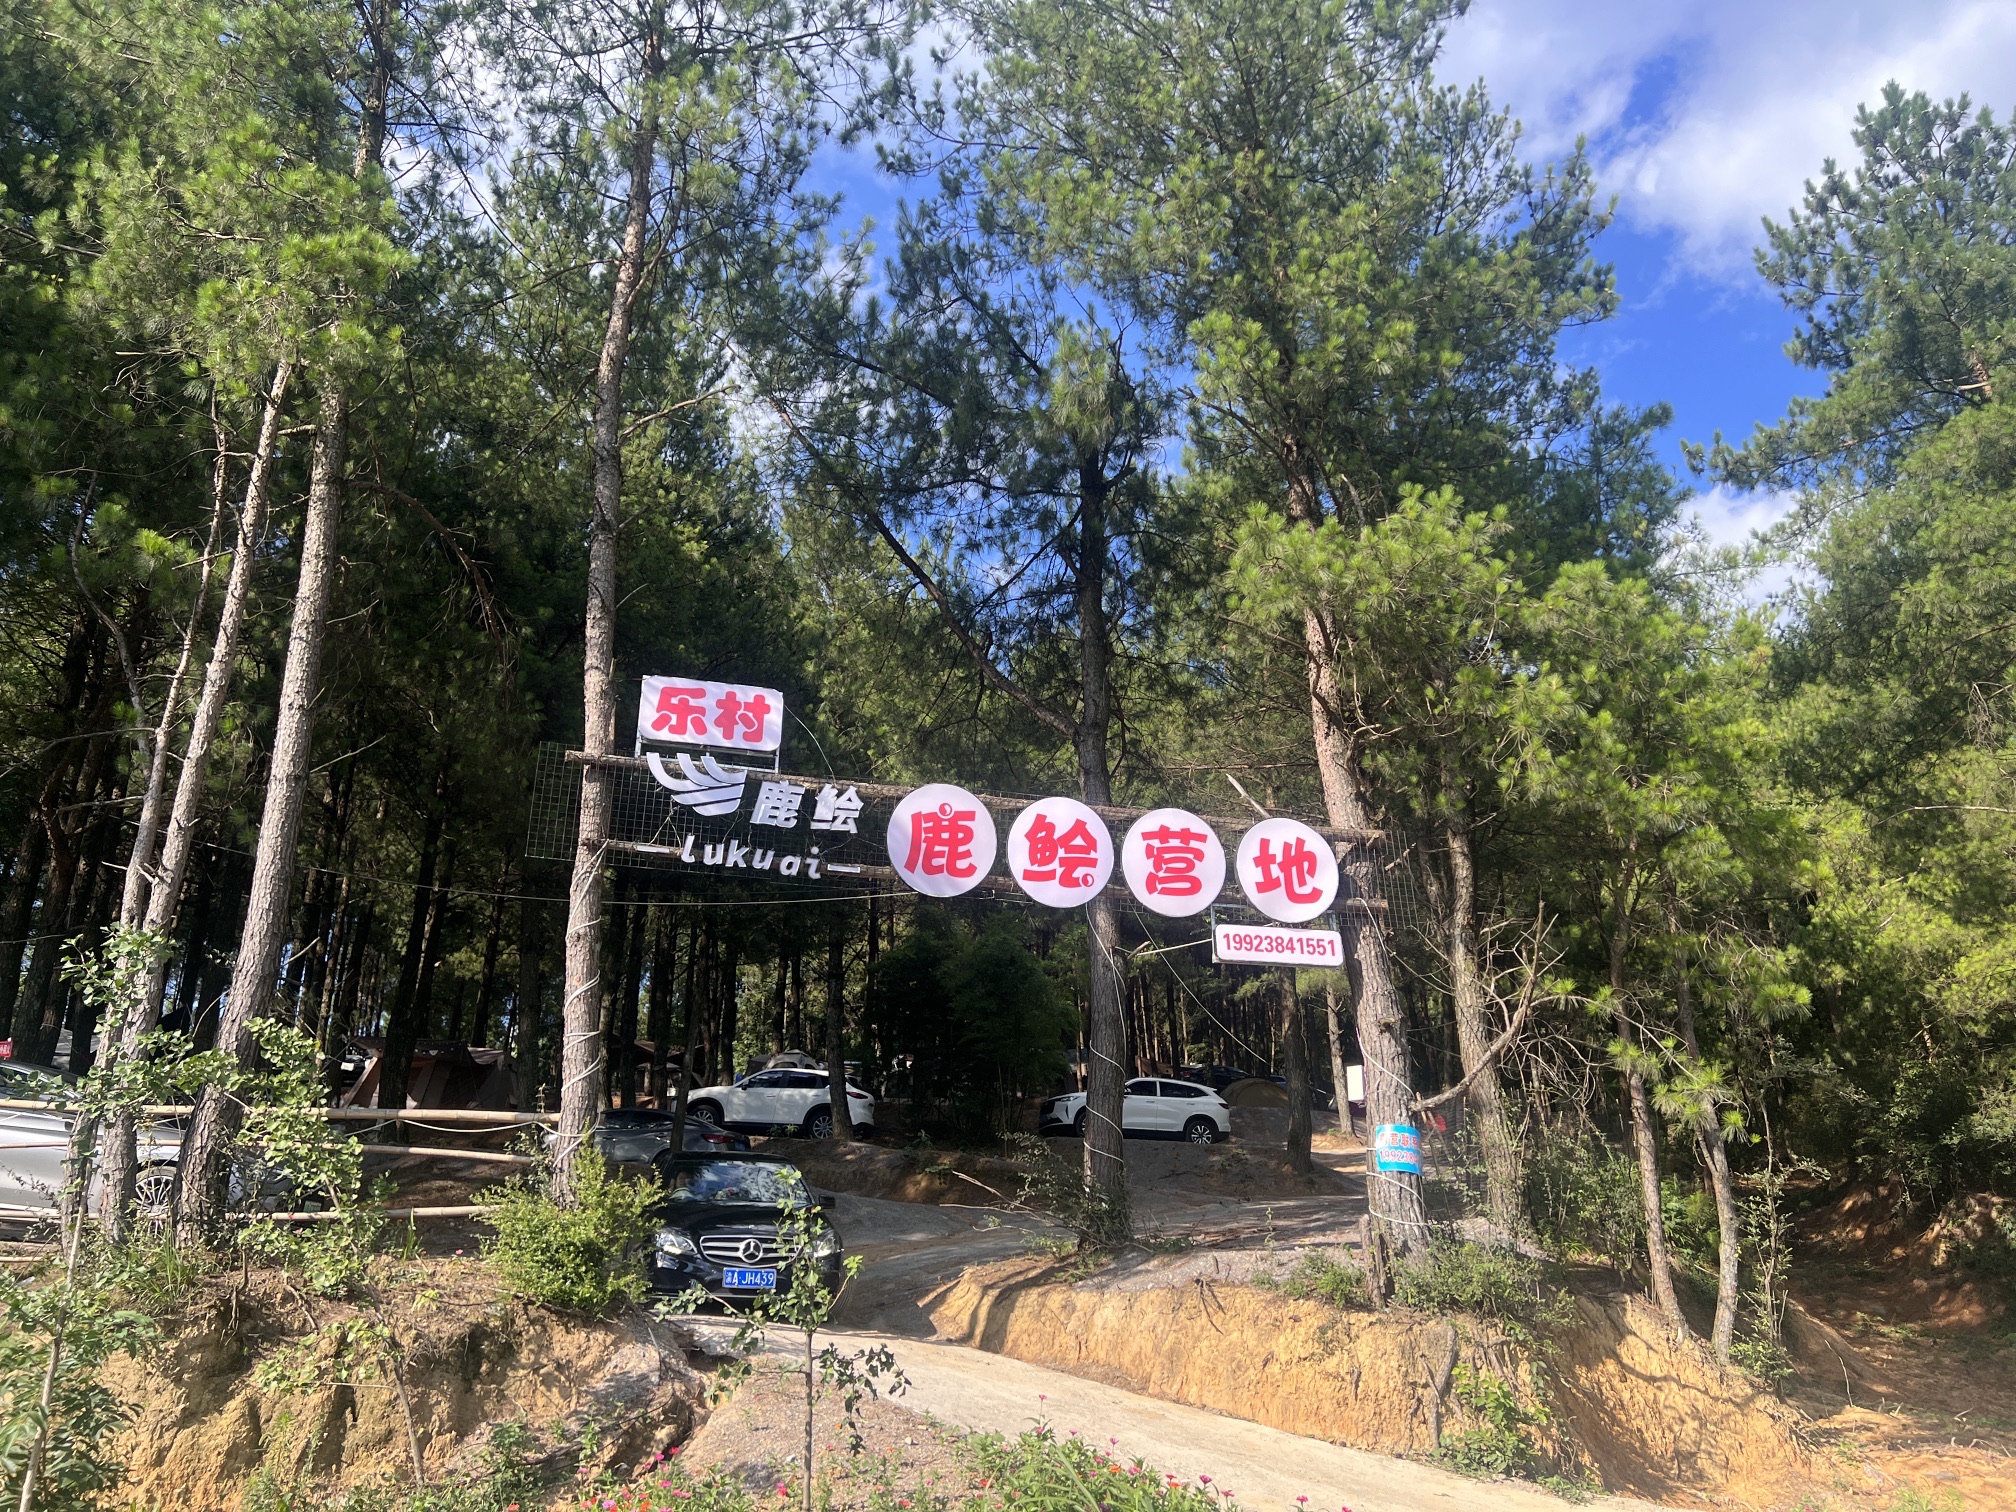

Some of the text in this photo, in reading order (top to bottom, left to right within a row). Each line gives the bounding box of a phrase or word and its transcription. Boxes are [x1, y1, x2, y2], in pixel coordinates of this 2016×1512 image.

[651, 686, 771, 743] 乐村
[680, 833, 821, 880] lukuai
[1223, 933, 1336, 957] 19923841551
